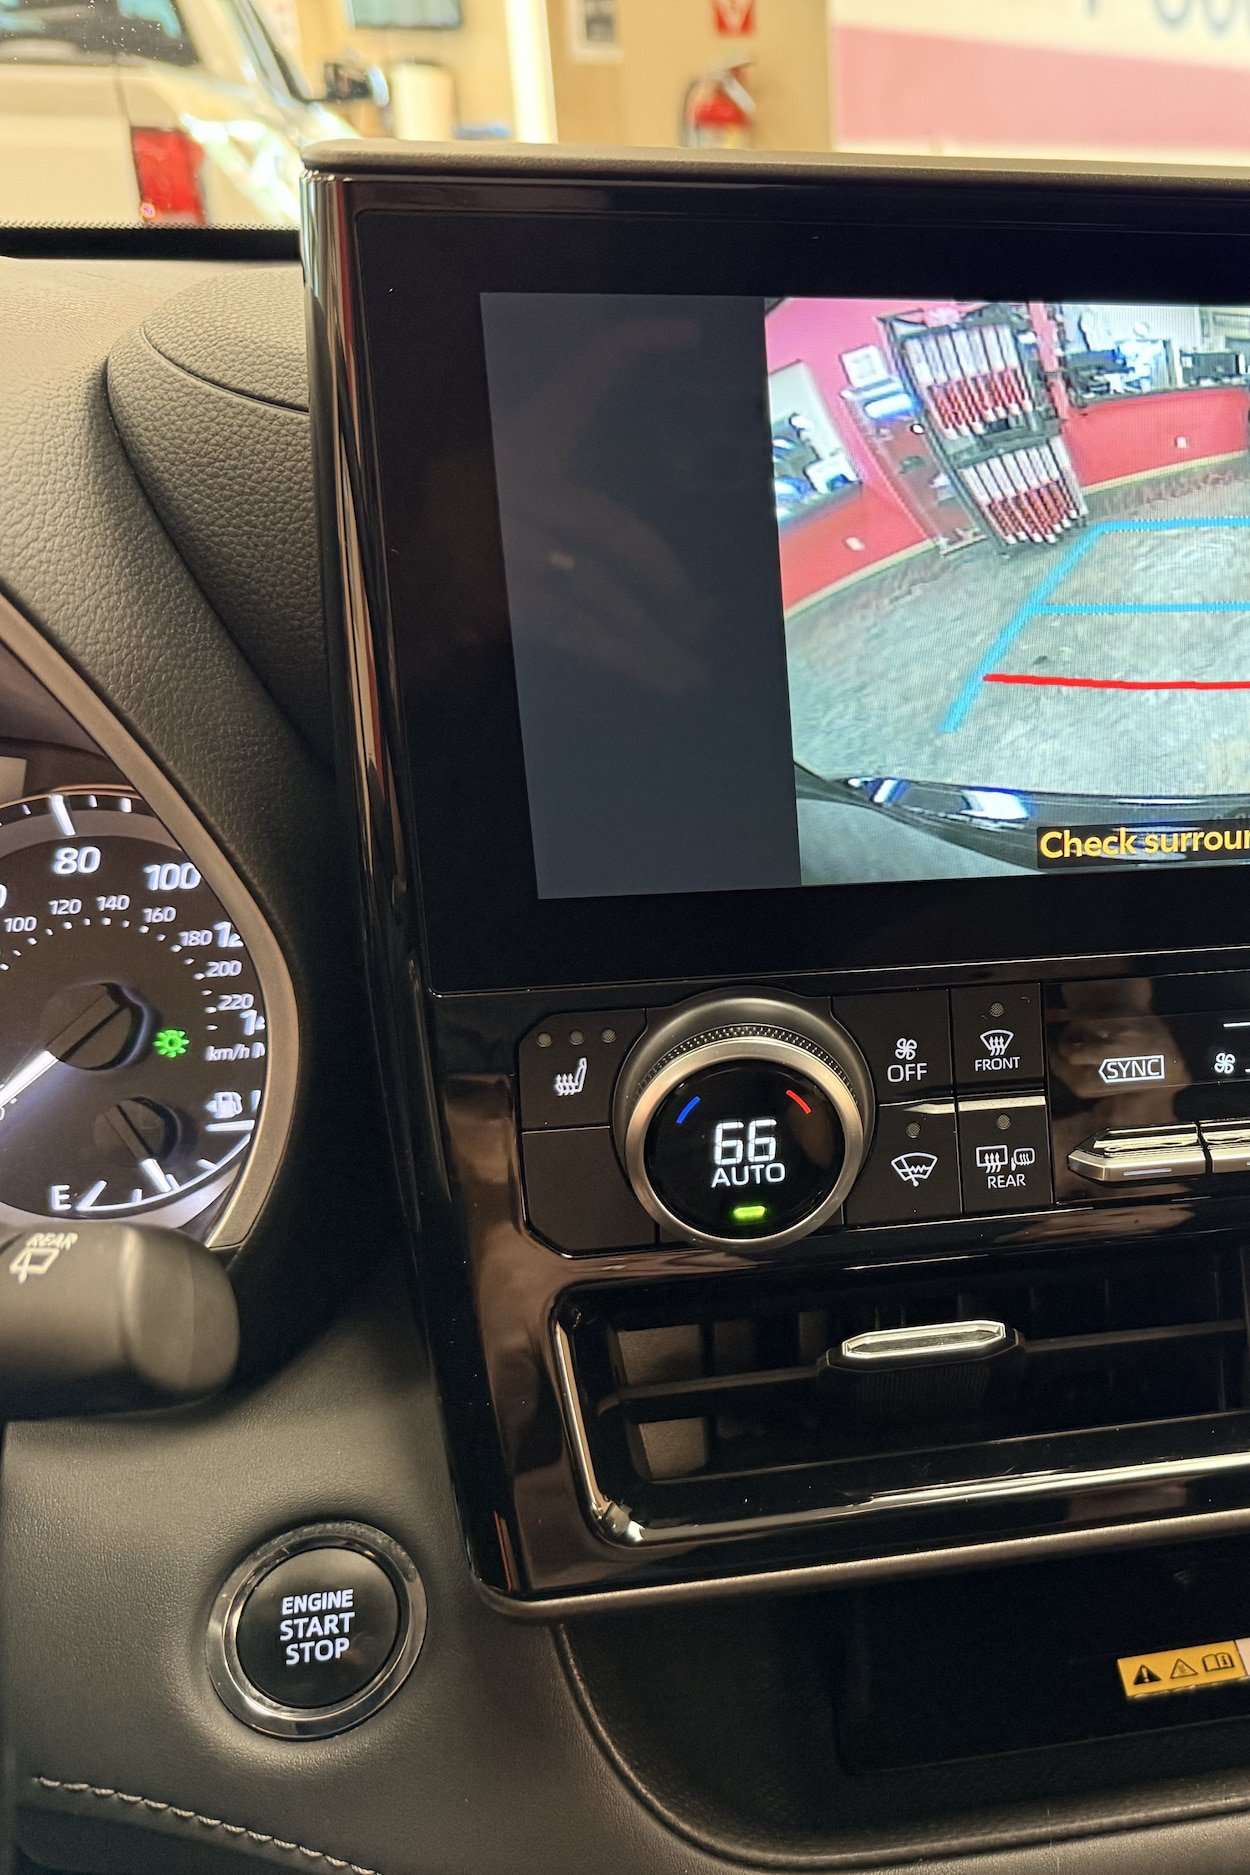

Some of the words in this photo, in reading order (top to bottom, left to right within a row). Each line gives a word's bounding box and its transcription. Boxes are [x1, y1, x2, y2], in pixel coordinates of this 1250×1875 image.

[1039, 827, 1137, 859] Check
[53, 846, 101, 875] 80
[143, 862, 201, 891] 100
[48, 899, 82, 916] 120
[96, 895, 130, 911] 140
[4, 916, 38, 933] 100
[142, 907, 177, 924] 160
[178, 930, 213, 946] 180
[205, 960, 242, 978] 200
[217, 994, 254, 1012] 220
[204, 1043, 251, 1062] km/h
[886, 1062, 928, 1083] OFF
[974, 1055, 1021, 1072] FRONT
[1106, 1059, 1161, 1080] SYNC
[712, 1118, 777, 1166] 66
[710, 1162, 786, 1189] AUTO
[986, 1174, 1027, 1190] REAR
[51, 1184, 73, 1211] E
[26, 1232, 79, 1250] REAR
[281, 1589, 354, 1615] ENGINE
[280, 1612, 355, 1641] START
[286, 1637, 350, 1665] STOP
